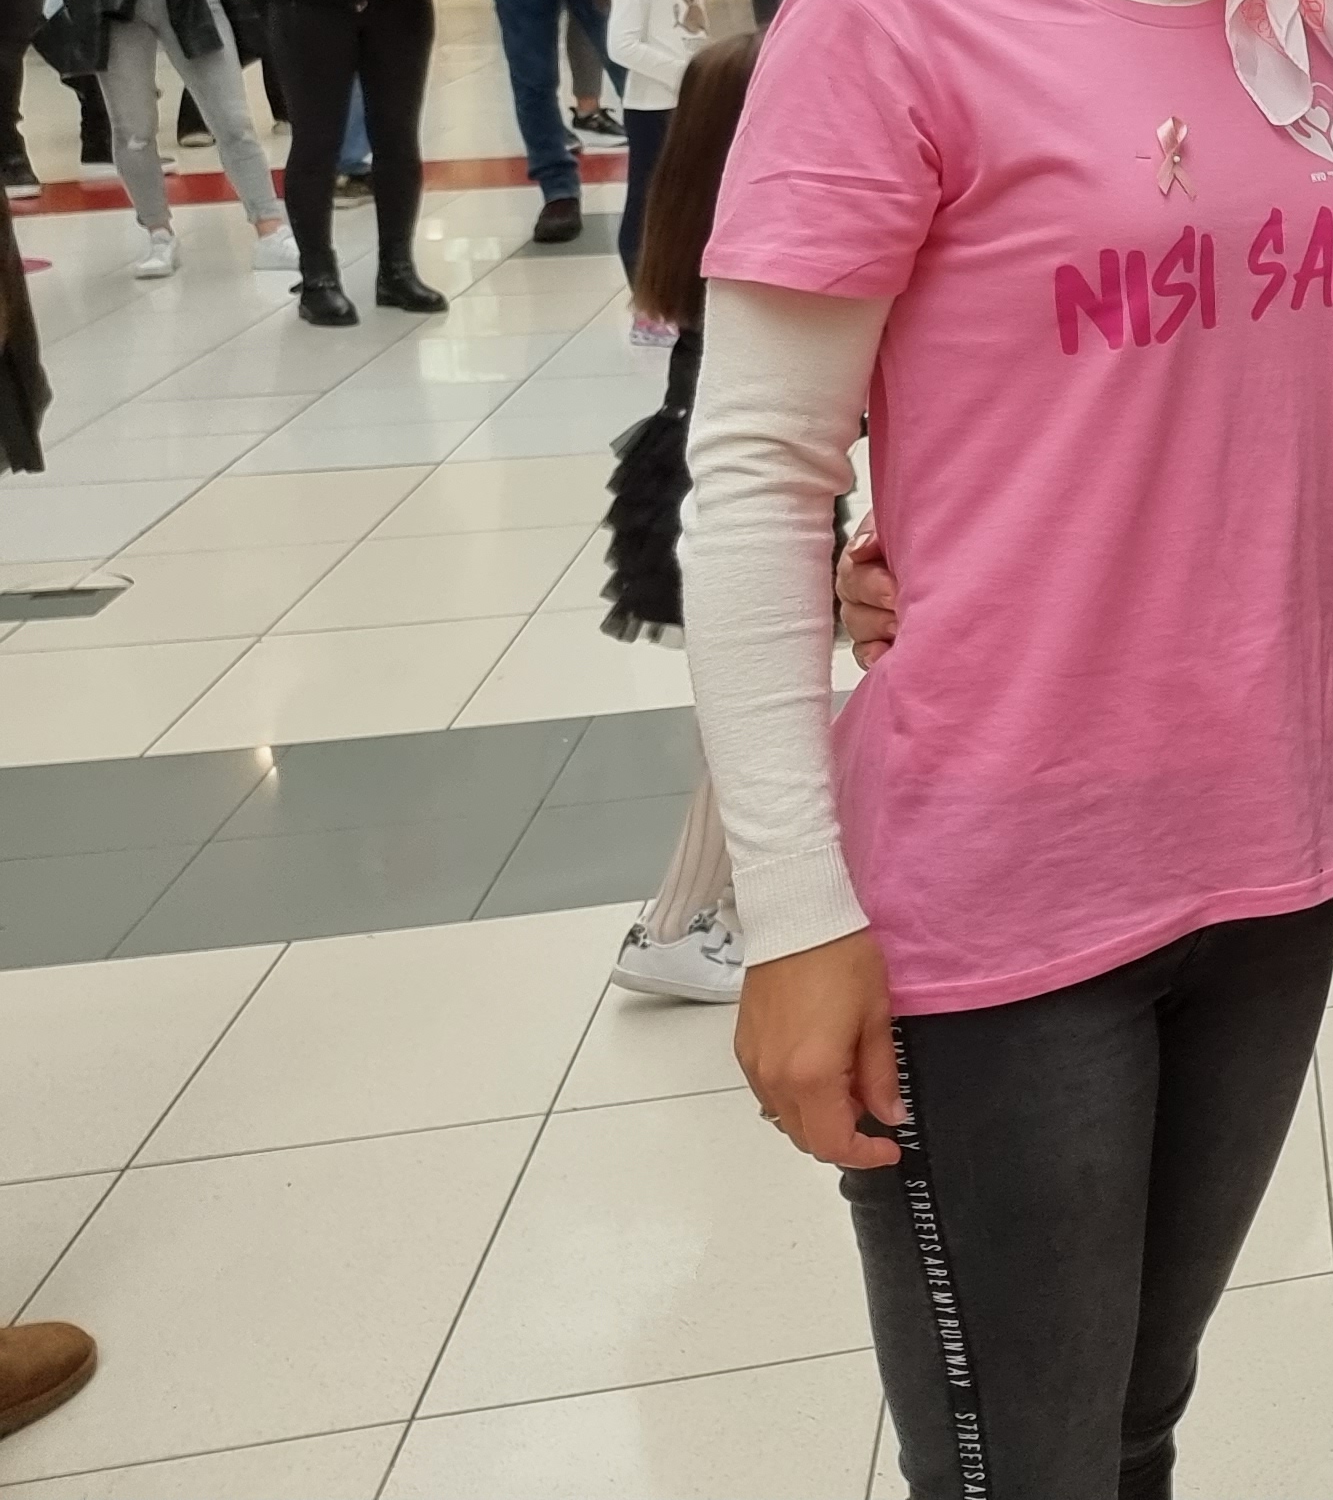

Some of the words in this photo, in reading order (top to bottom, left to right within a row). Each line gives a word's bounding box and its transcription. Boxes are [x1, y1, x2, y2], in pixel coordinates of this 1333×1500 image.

[1055, 226, 1216, 355] NISI
[905, 1180, 942, 1252] STREETS
[923, 1256, 950, 1286] ARE
[932, 1291, 957, 1314] MY
[938, 1318, 971, 1387] RUNWAY
[954, 1412, 985, 1480] STREETS
